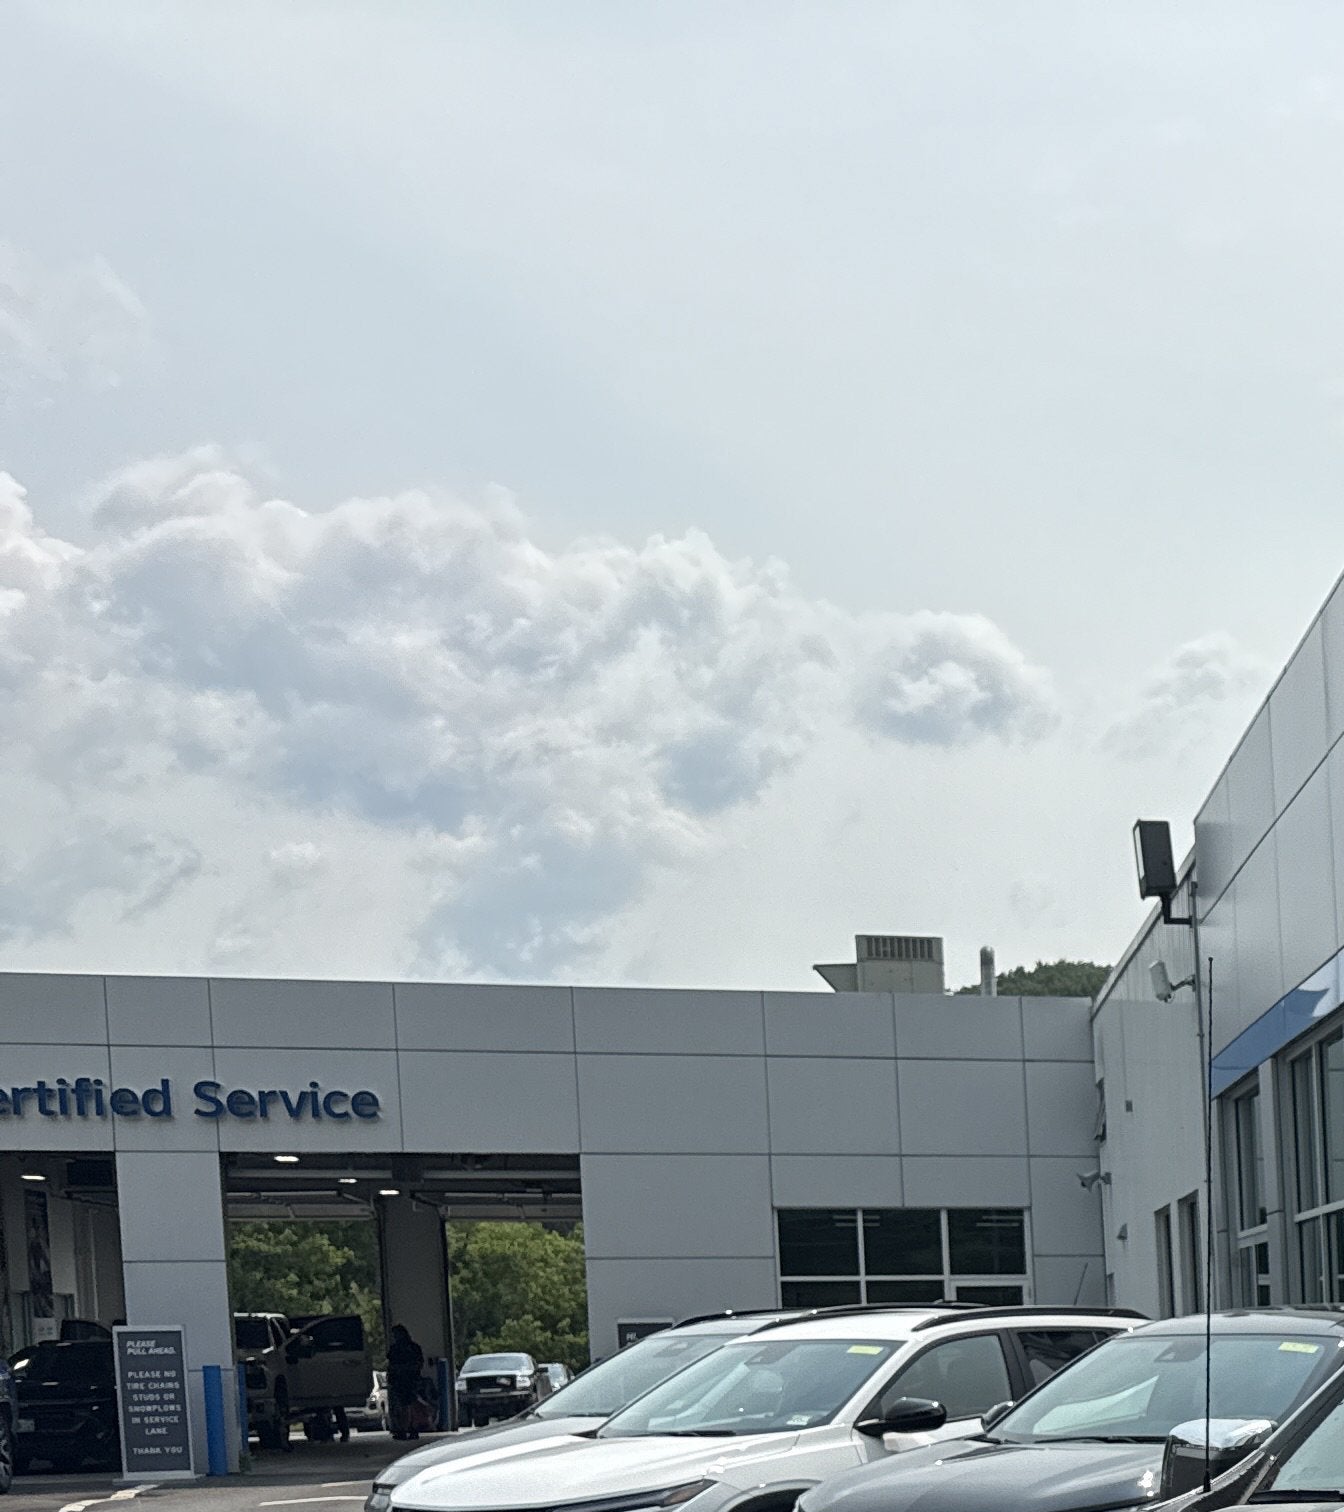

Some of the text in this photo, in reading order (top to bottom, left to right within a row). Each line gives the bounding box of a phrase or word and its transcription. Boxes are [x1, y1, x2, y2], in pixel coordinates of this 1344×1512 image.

[193, 1080, 381, 1120] Service
[127, 1347, 147, 1355] PULL
[128, 1370, 176, 1379] PLEASE NO
[127, 1382, 144, 1390] TIRE
[132, 1392, 175, 1401] STUDS OR
[128, 1404, 182, 1413] SNOWPLOWS
[132, 1415, 179, 1424] IN SERVICE
[145, 1427, 167, 1436] LANE
[133, 1446, 183, 1455] THANK YOU
